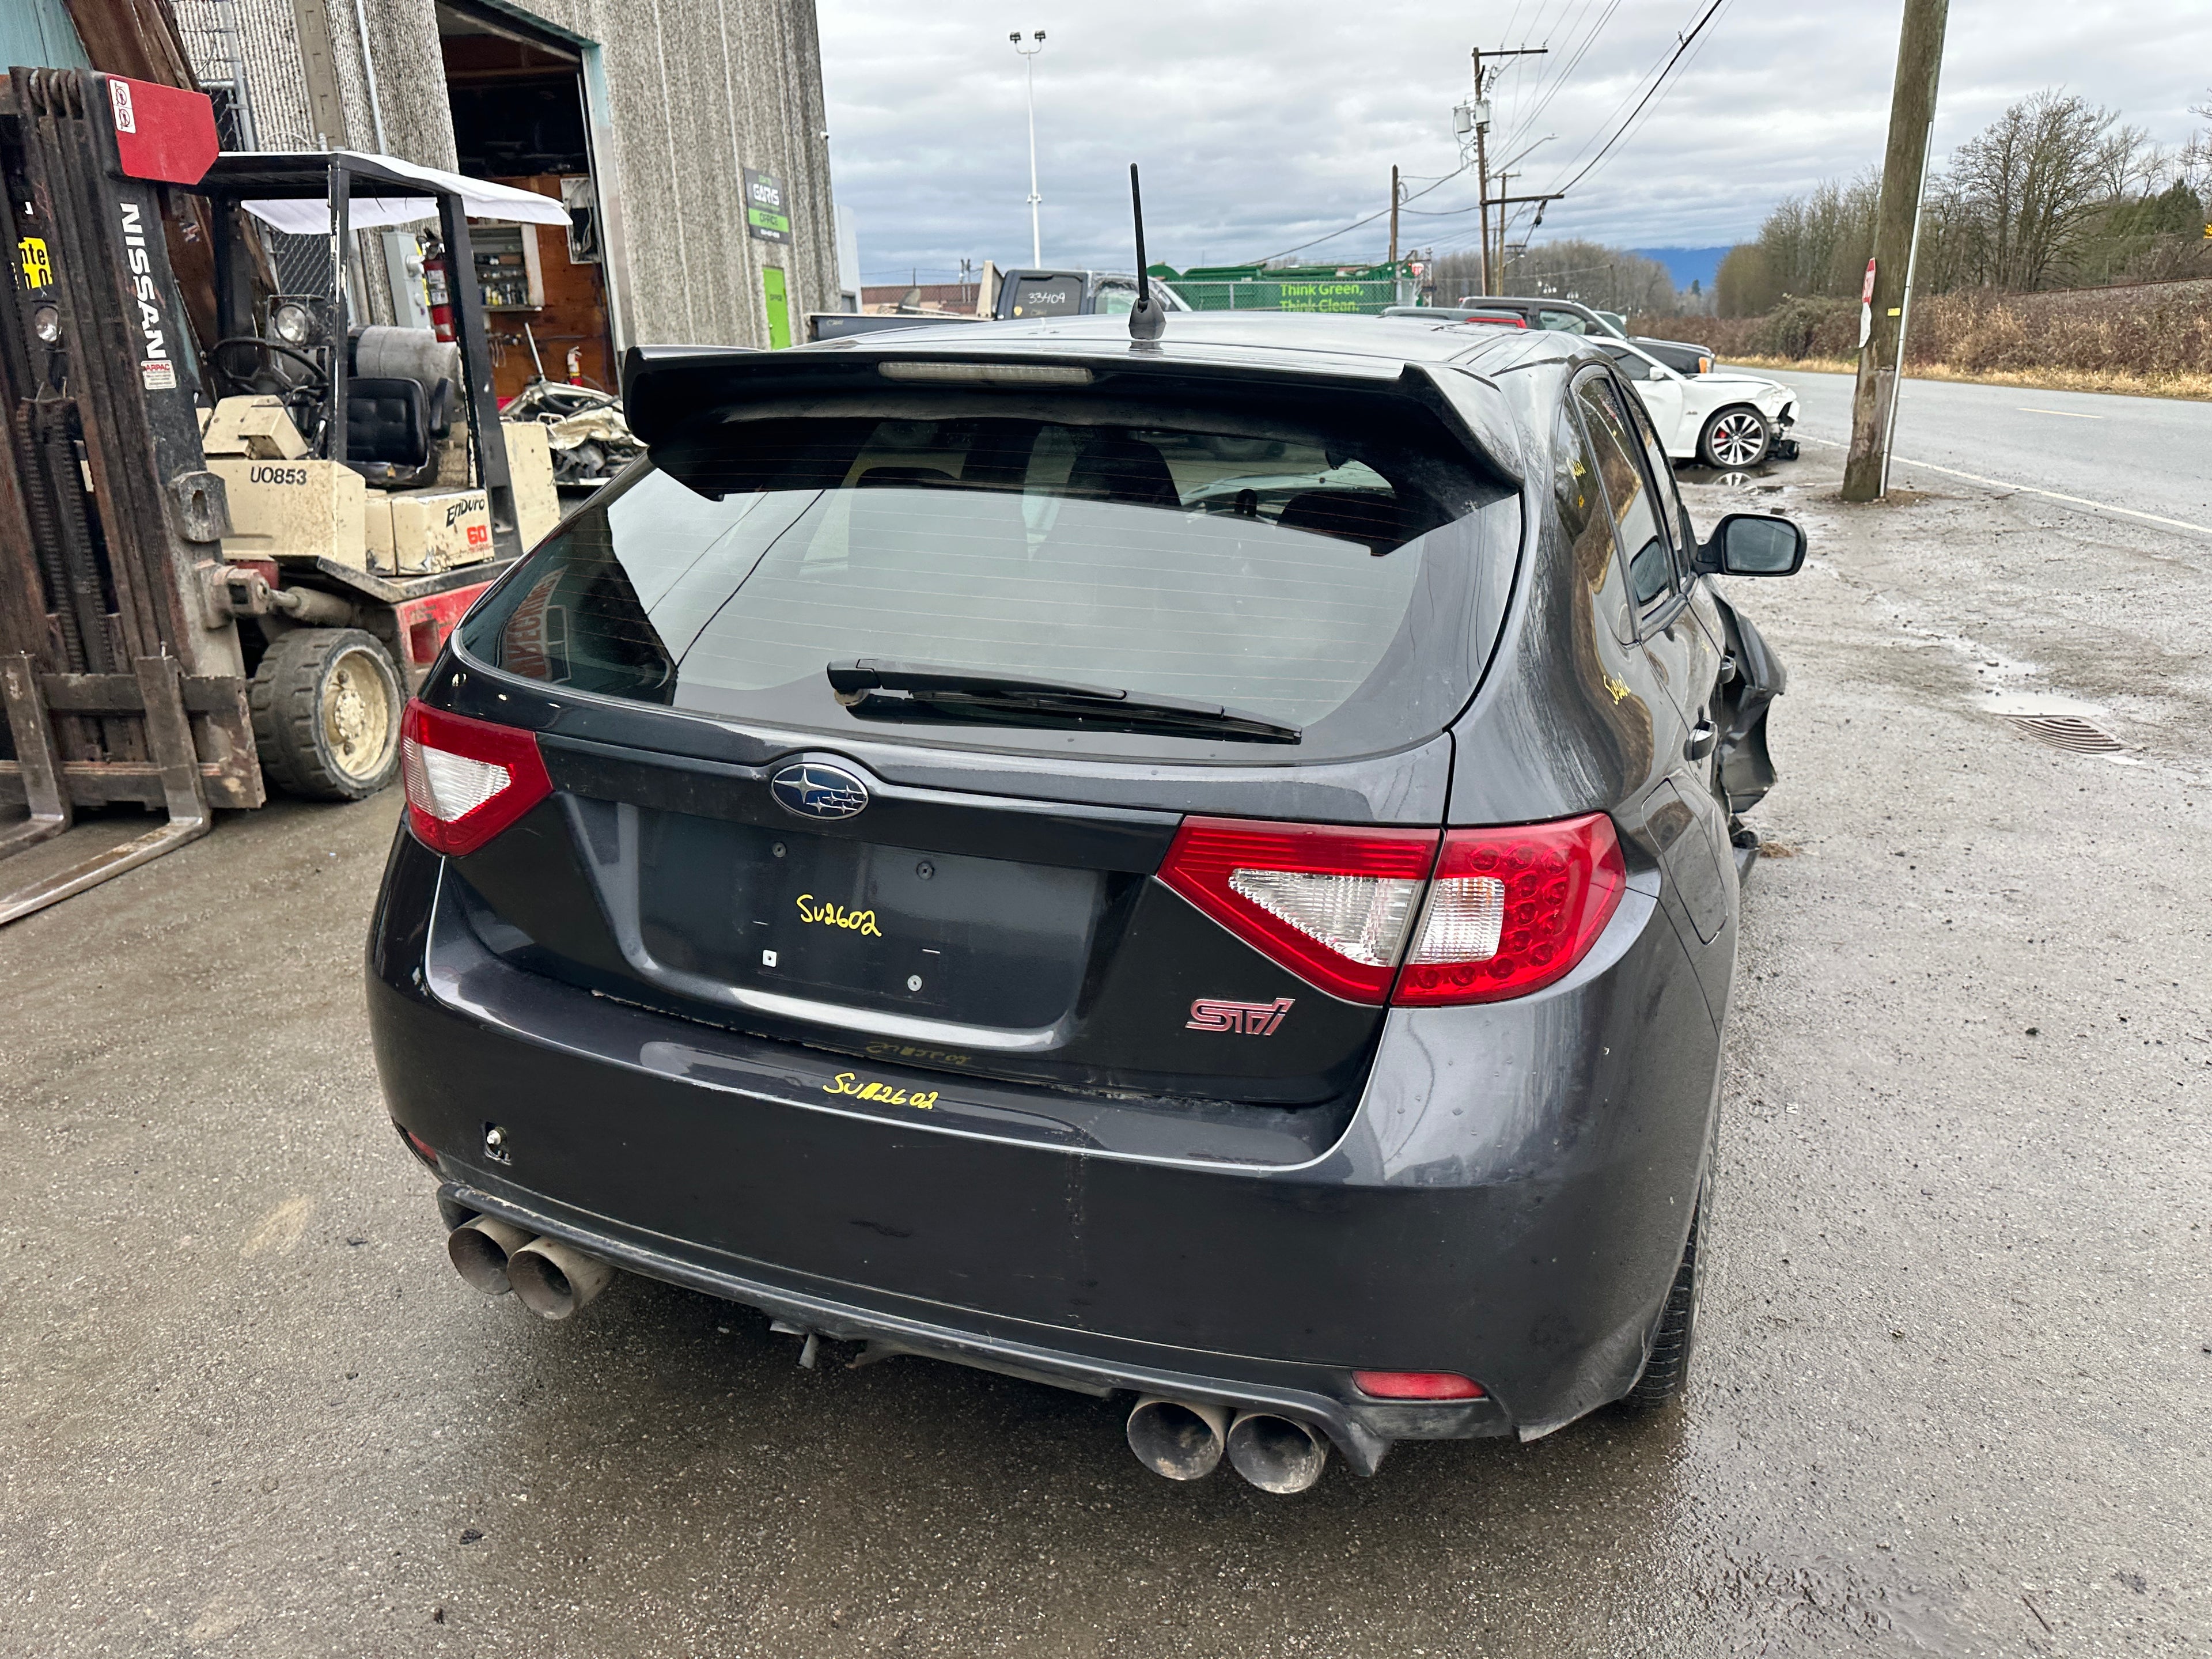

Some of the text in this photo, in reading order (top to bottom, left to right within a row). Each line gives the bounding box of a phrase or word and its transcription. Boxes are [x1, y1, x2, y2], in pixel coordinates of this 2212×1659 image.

[120, 203, 167, 359] NISSAN
[1279, 283, 1365, 297] Think Green,
[1028, 291, 1066, 304] 33409
[1279, 298, 1360, 312] Think Clean.
[467, 525, 488, 545] 60
